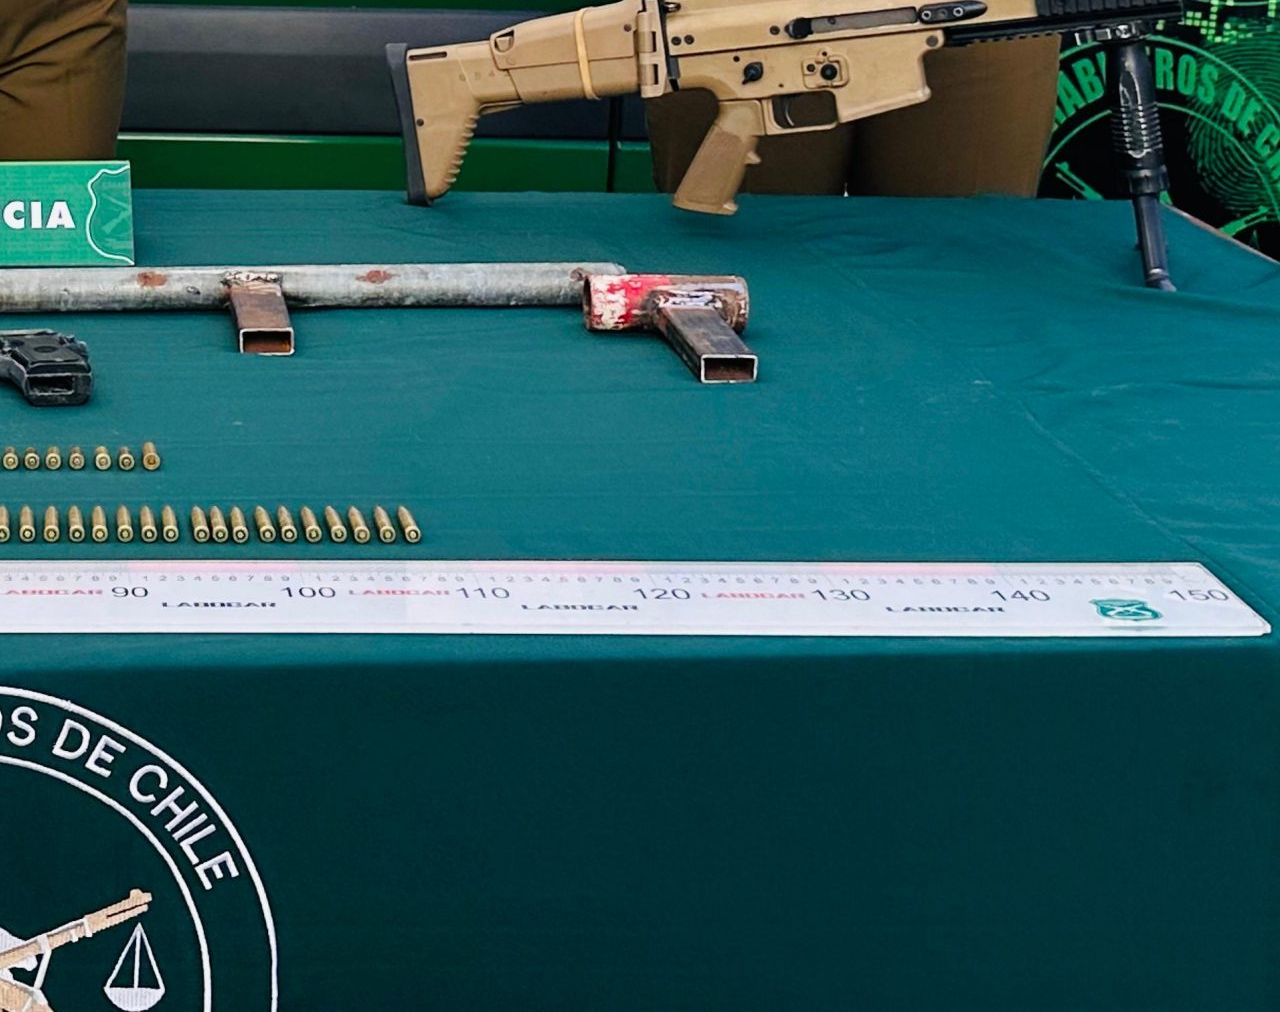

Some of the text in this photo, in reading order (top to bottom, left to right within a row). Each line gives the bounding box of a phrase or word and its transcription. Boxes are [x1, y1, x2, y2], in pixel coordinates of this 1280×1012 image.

[110, 586, 148, 598] 90
[280, 586, 336, 598] 100
[456, 586, 510, 598] 110
[632, 588, 692, 600] 120
[810, 588, 872, 602] 130
[990, 590, 1050, 602] 140
[1168, 588, 1229, 602] 150
[52, 717, 126, 779] DE
[129, 763, 241, 891] CHILE
